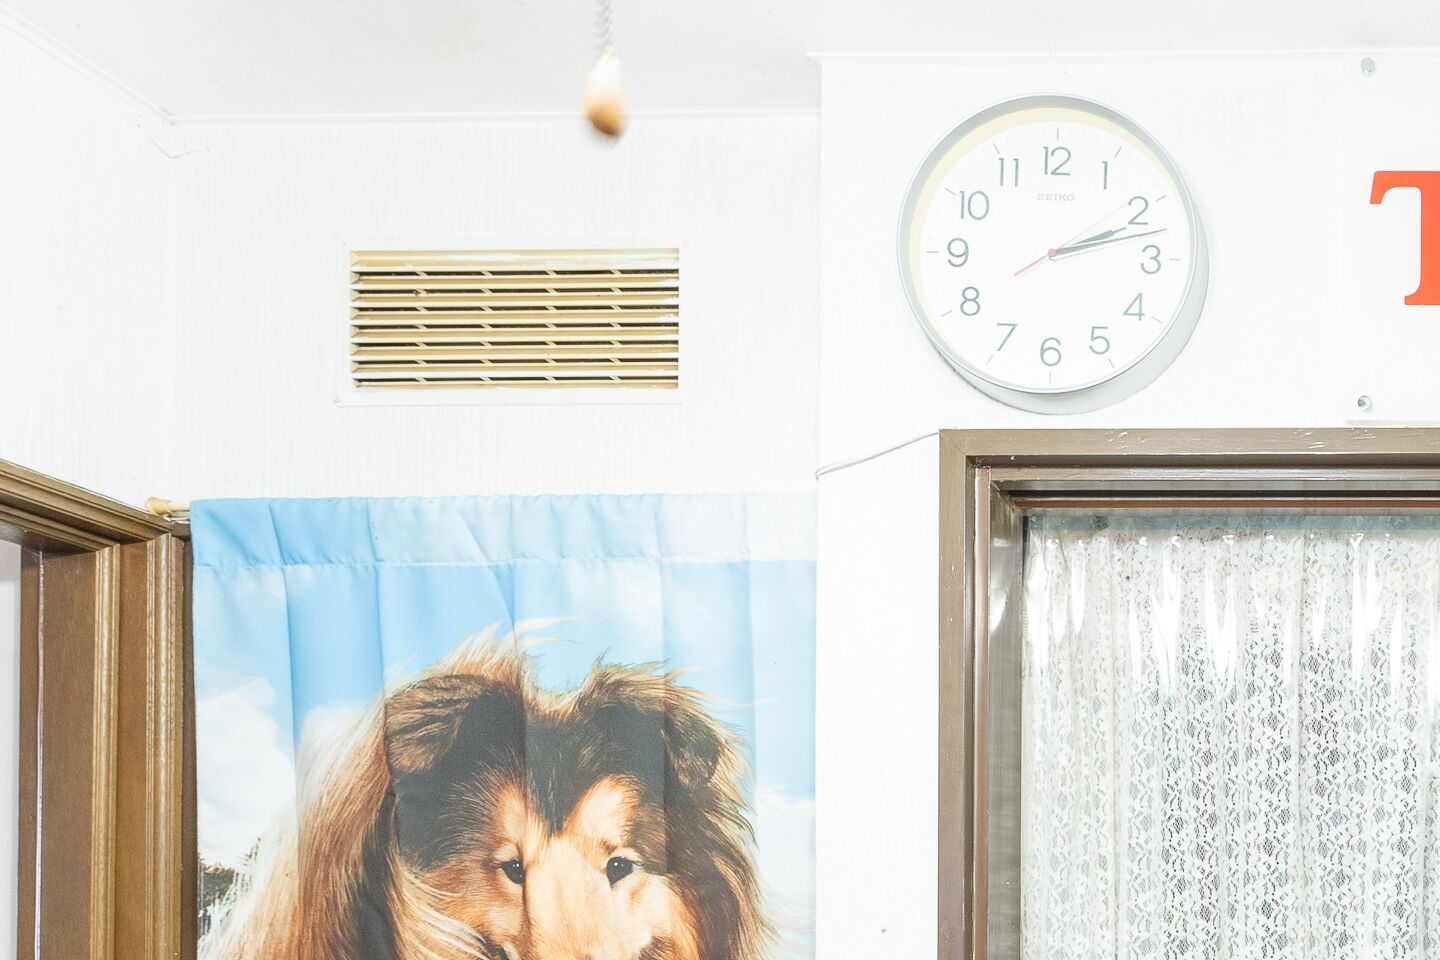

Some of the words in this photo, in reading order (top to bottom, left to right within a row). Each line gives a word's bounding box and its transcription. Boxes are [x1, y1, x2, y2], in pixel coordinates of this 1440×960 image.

[998, 157, 1020, 187] 11
[1042, 146, 1072, 176] 12
[1101, 160, 1109, 190] 1
[960, 190, 990, 220] 10
[1036, 192, 1076, 202] SEIKO
[1127, 196, 1149, 226] 2
[947, 238, 970, 267] 9
[1140, 244, 1162, 275] 3
[959, 286, 981, 317] 8
[1123, 292, 1146, 321] 4
[996, 323, 1018, 352] 7
[1040, 337, 1062, 367] 6
[1089, 326, 1111, 355] 5
